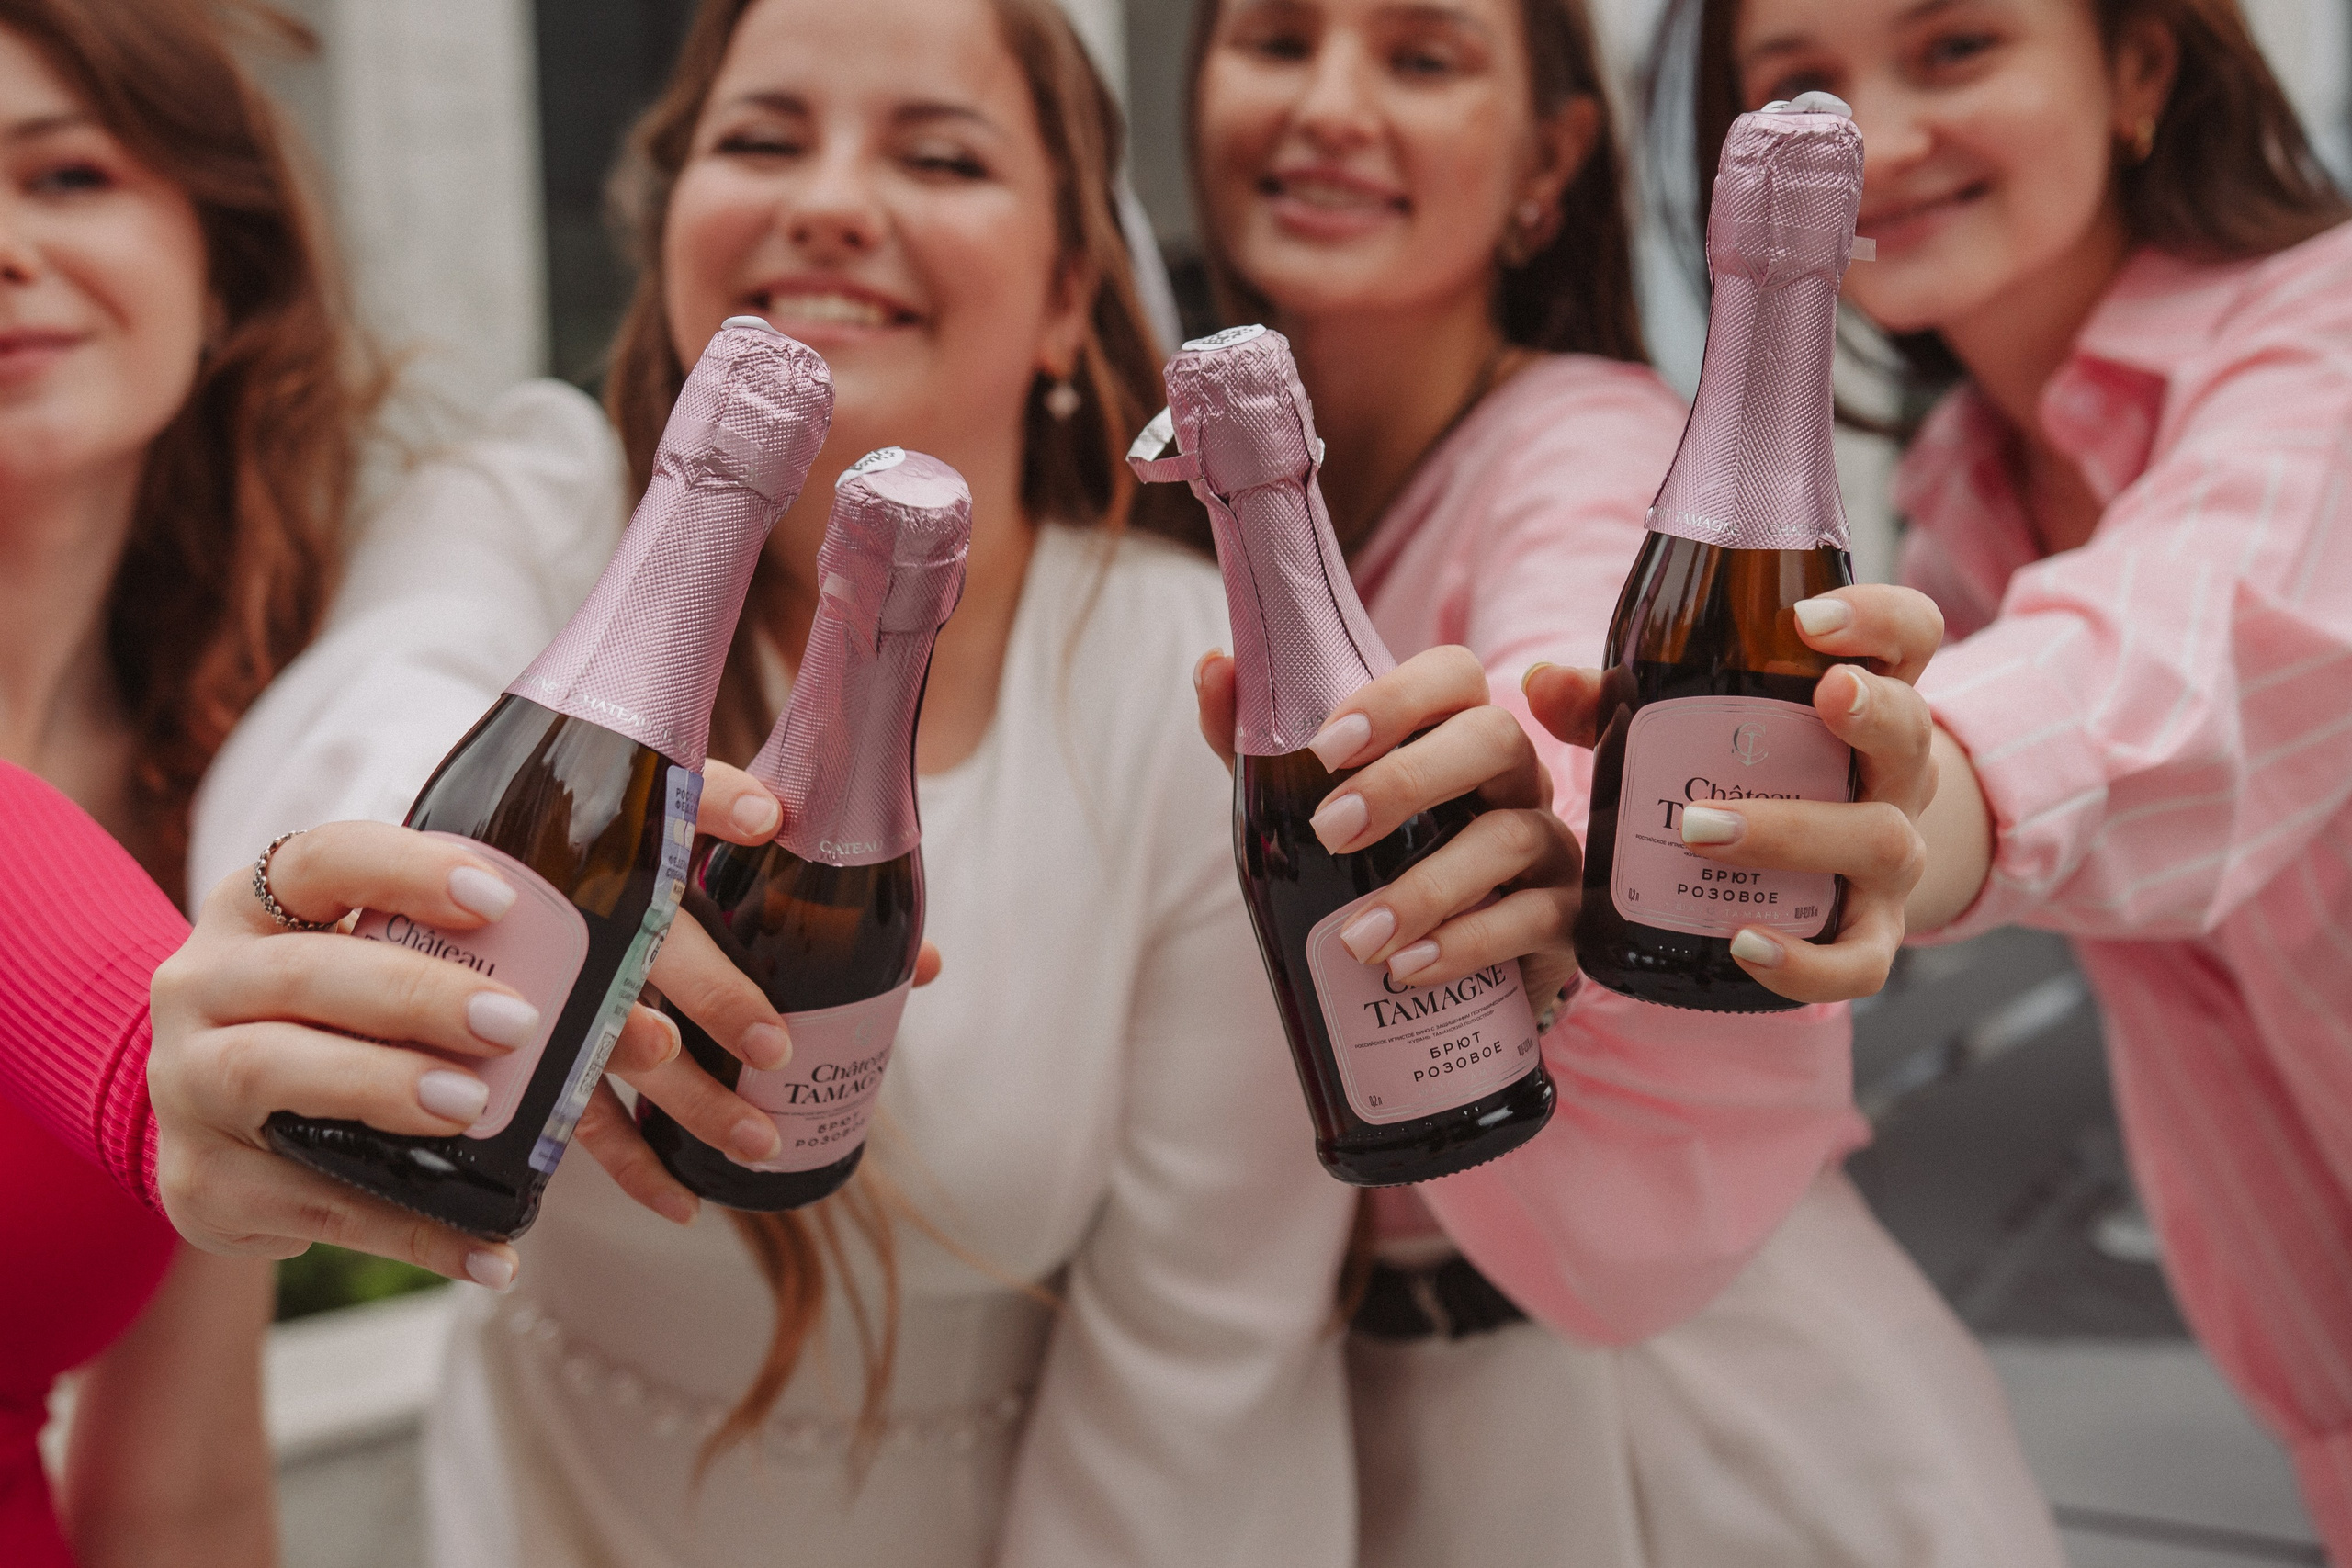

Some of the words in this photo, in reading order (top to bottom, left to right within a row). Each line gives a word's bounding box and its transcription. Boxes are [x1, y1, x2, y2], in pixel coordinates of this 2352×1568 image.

[1702, 868, 1761, 886] БРЮТ
[1677, 883, 1779, 904] РОЗОВОЕ
[1363, 964, 1506, 1029] TAMAGNE
[1430, 1031, 1481, 1059] БРЮТ
[1413, 1041, 1503, 1082] РОЗОВОЕ
